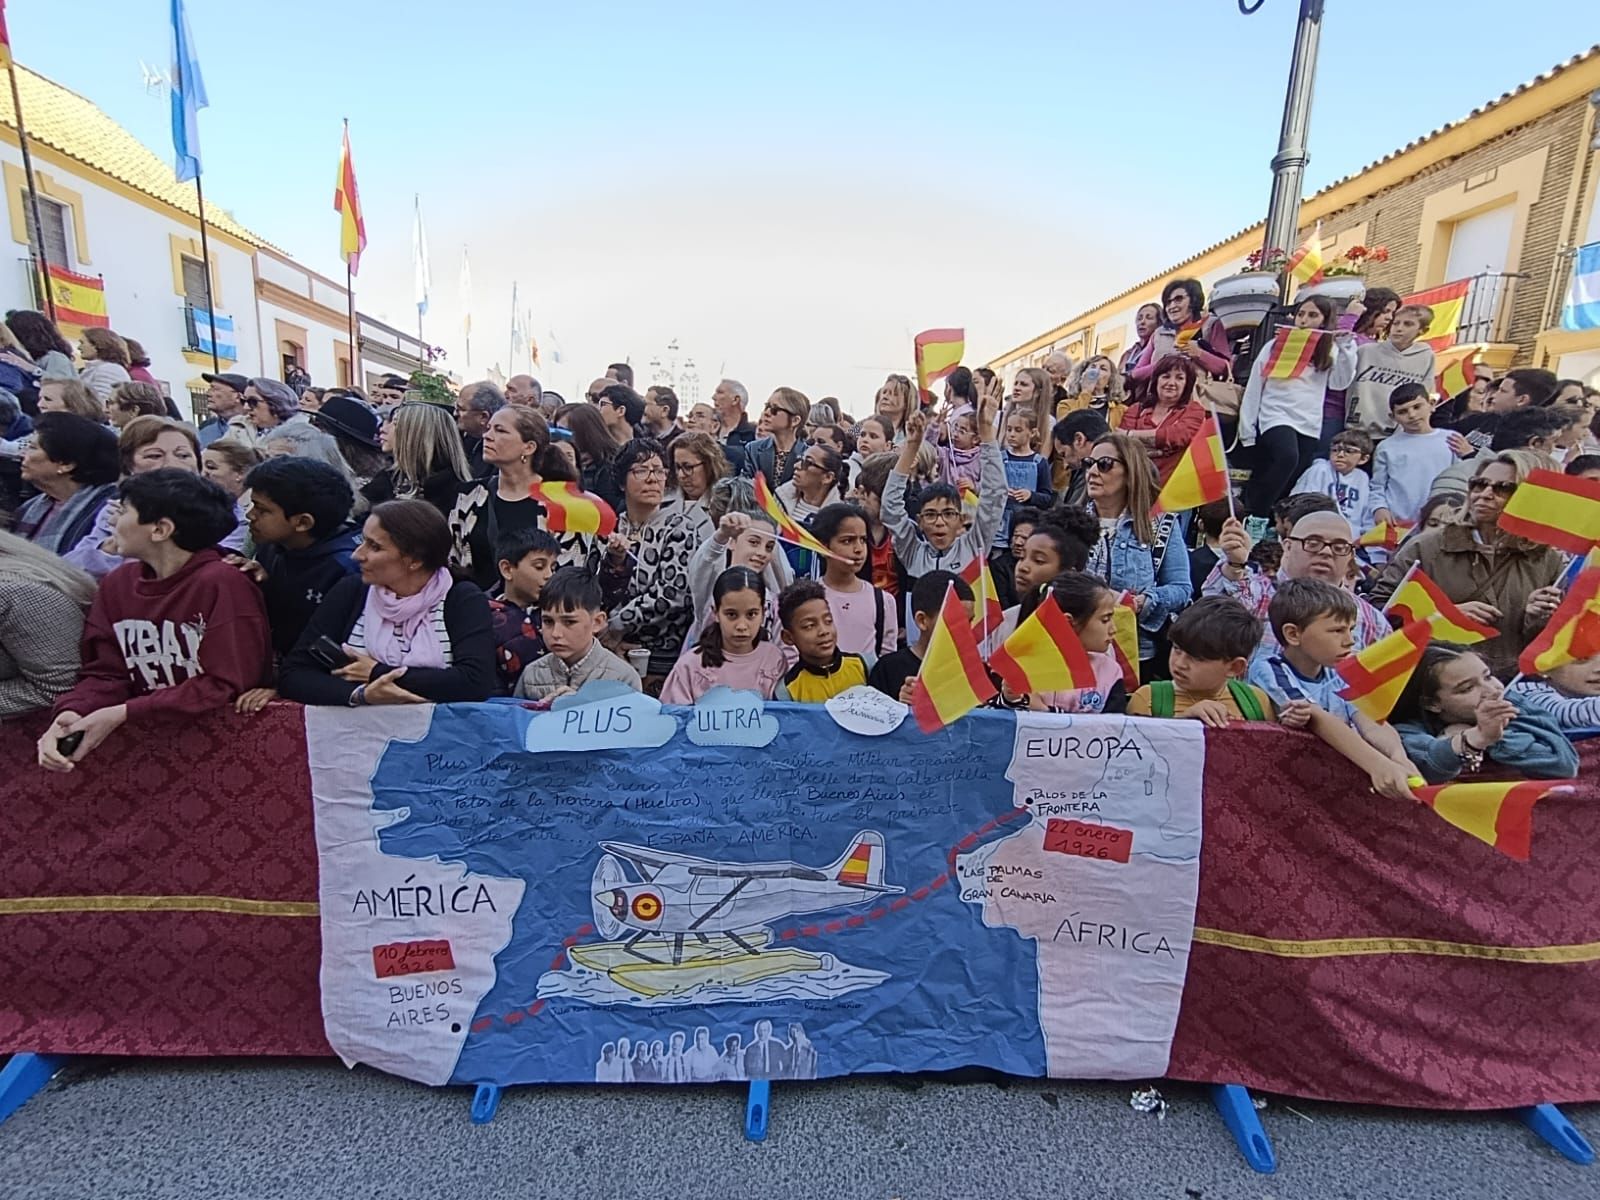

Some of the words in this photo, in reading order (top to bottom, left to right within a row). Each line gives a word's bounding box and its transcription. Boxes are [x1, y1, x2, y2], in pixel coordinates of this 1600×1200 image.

[562, 706, 633, 735] PLUS
[698, 707, 762, 733] ULTRA
[1026, 736, 1143, 760] EUROPA
[423, 753, 468, 773] Plus
[848, 750, 903, 767] Militar
[895, 766, 992, 786] Calzadilla
[499, 793, 520, 808] de
[623, 790, 701, 810] (Huelva)
[806, 785, 860, 801] Buenos
[861, 786, 905, 801] Aires
[1029, 788, 1067, 799] PALOS
[1071, 791, 1086, 799] DE
[1092, 790, 1108, 800] LA
[1036, 802, 1102, 816] FRONTERA
[1049, 821, 1068, 834] 22
[1073, 827, 1123, 843] enero
[1055, 839, 1109, 859] 1926
[963, 864, 985, 878] LAS
[989, 864, 1043, 879] PALMAS
[986, 874, 1004, 883] DE
[352, 873, 497, 918] AMÉRICA
[962, 888, 994, 902] GRAN
[999, 886, 1057, 903] CANARIA
[1052, 911, 1176, 960] ÁFRICA
[377, 946, 398, 961] 10
[398, 943, 451, 964] febrero
[385, 960, 435, 977] 1926
[388, 978, 463, 1005] BUENOS
[386, 1002, 452, 1029] AIRES
